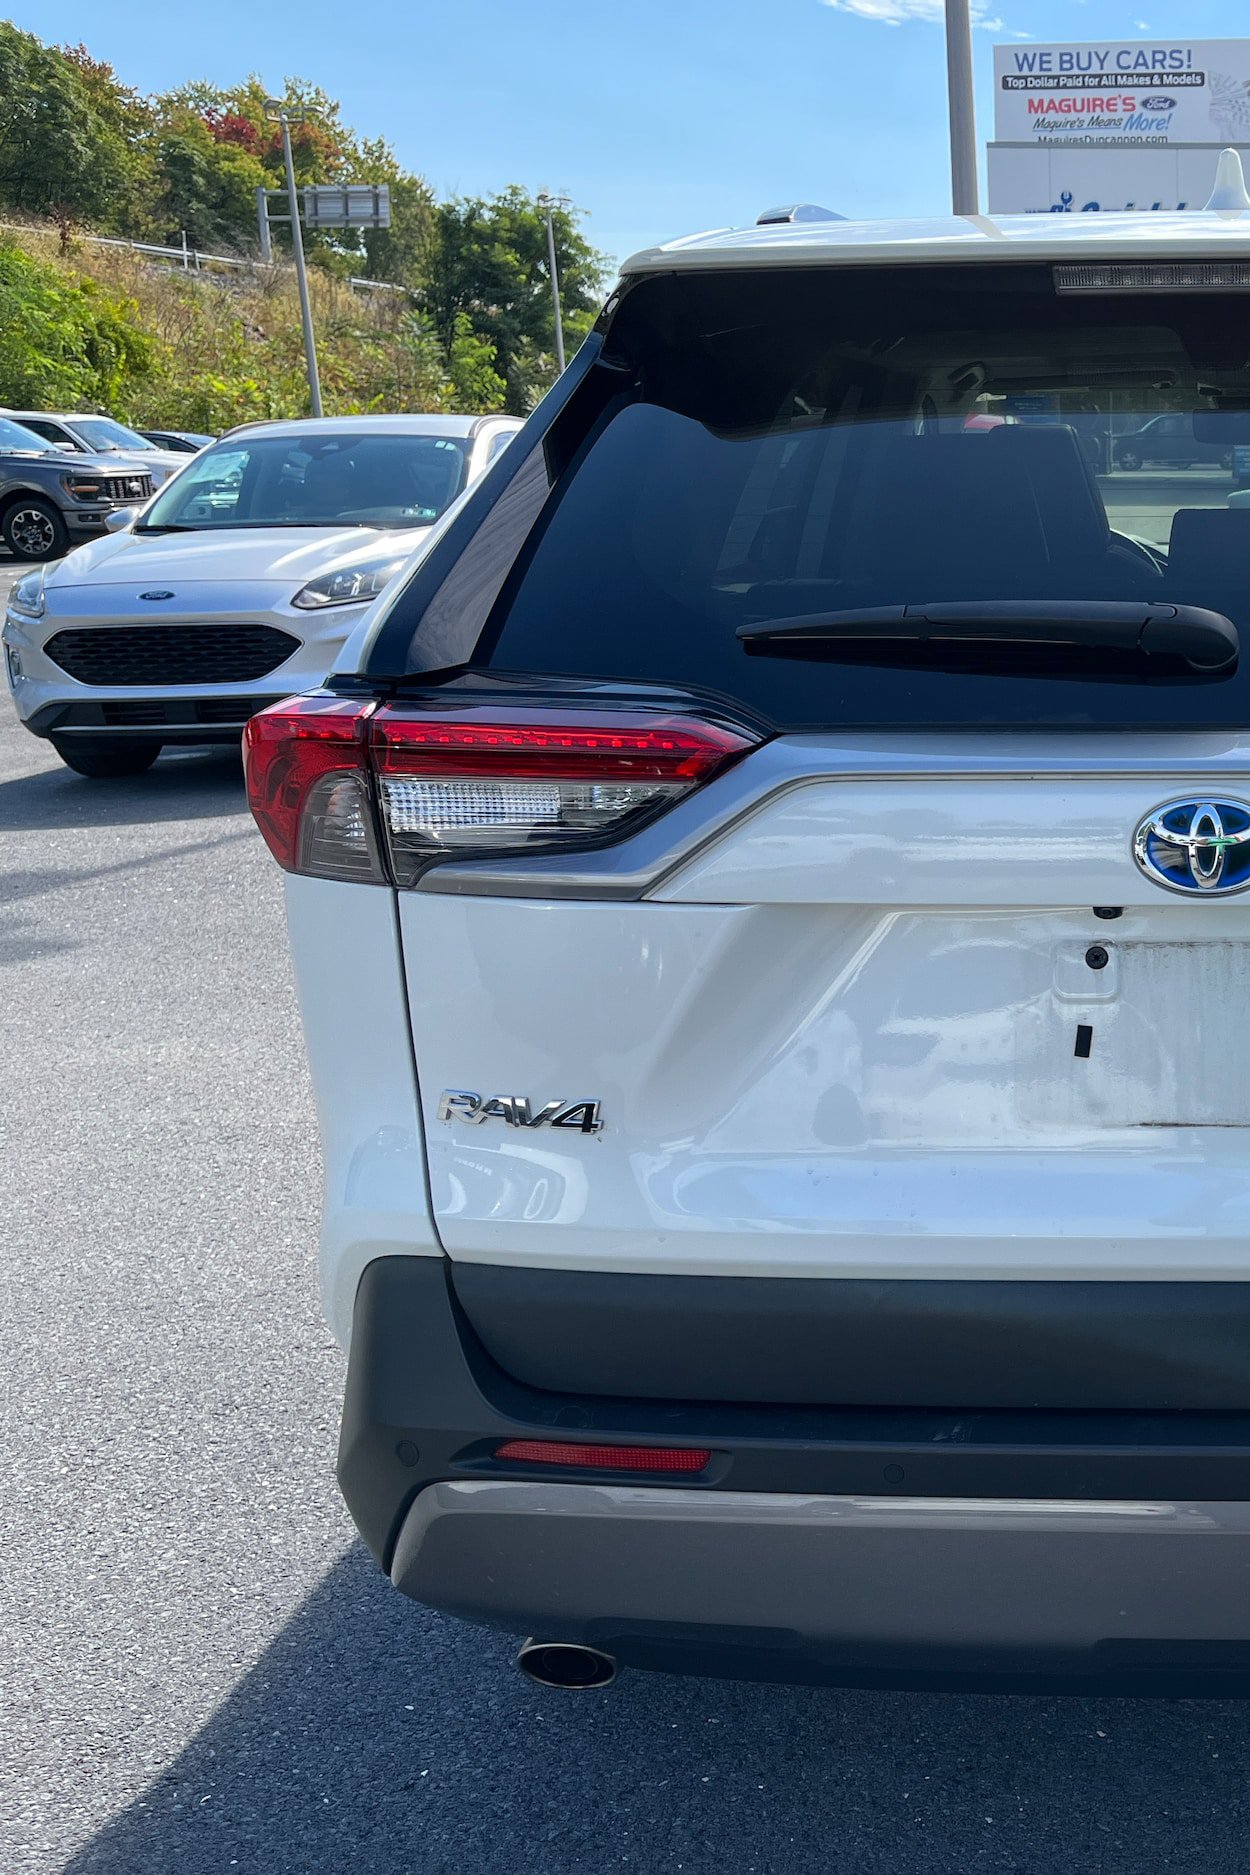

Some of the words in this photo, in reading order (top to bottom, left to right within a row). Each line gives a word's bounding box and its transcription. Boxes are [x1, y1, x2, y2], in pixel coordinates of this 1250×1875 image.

[1014, 52, 1052, 72] WE
[1059, 50, 1110, 71] BUY
[1116, 49, 1192, 70] CARS!
[1006, 77, 1026, 89] Top
[1027, 76, 1058, 87] Dollar
[1059, 75, 1083, 87] Paid
[1084, 75, 1100, 86] for
[1100, 75, 1116, 86] All
[1117, 74, 1151, 85] Makes
[1152, 74, 1161, 85] &
[1162, 73, 1202, 85] Models
[1027, 94, 1136, 114] MAGUIRE'S
[1033, 117, 1085, 132] Maguire's
[1087, 115, 1123, 127] Means
[1123, 112, 1173, 131] More!
[437, 1089, 604, 1135] RAV4
